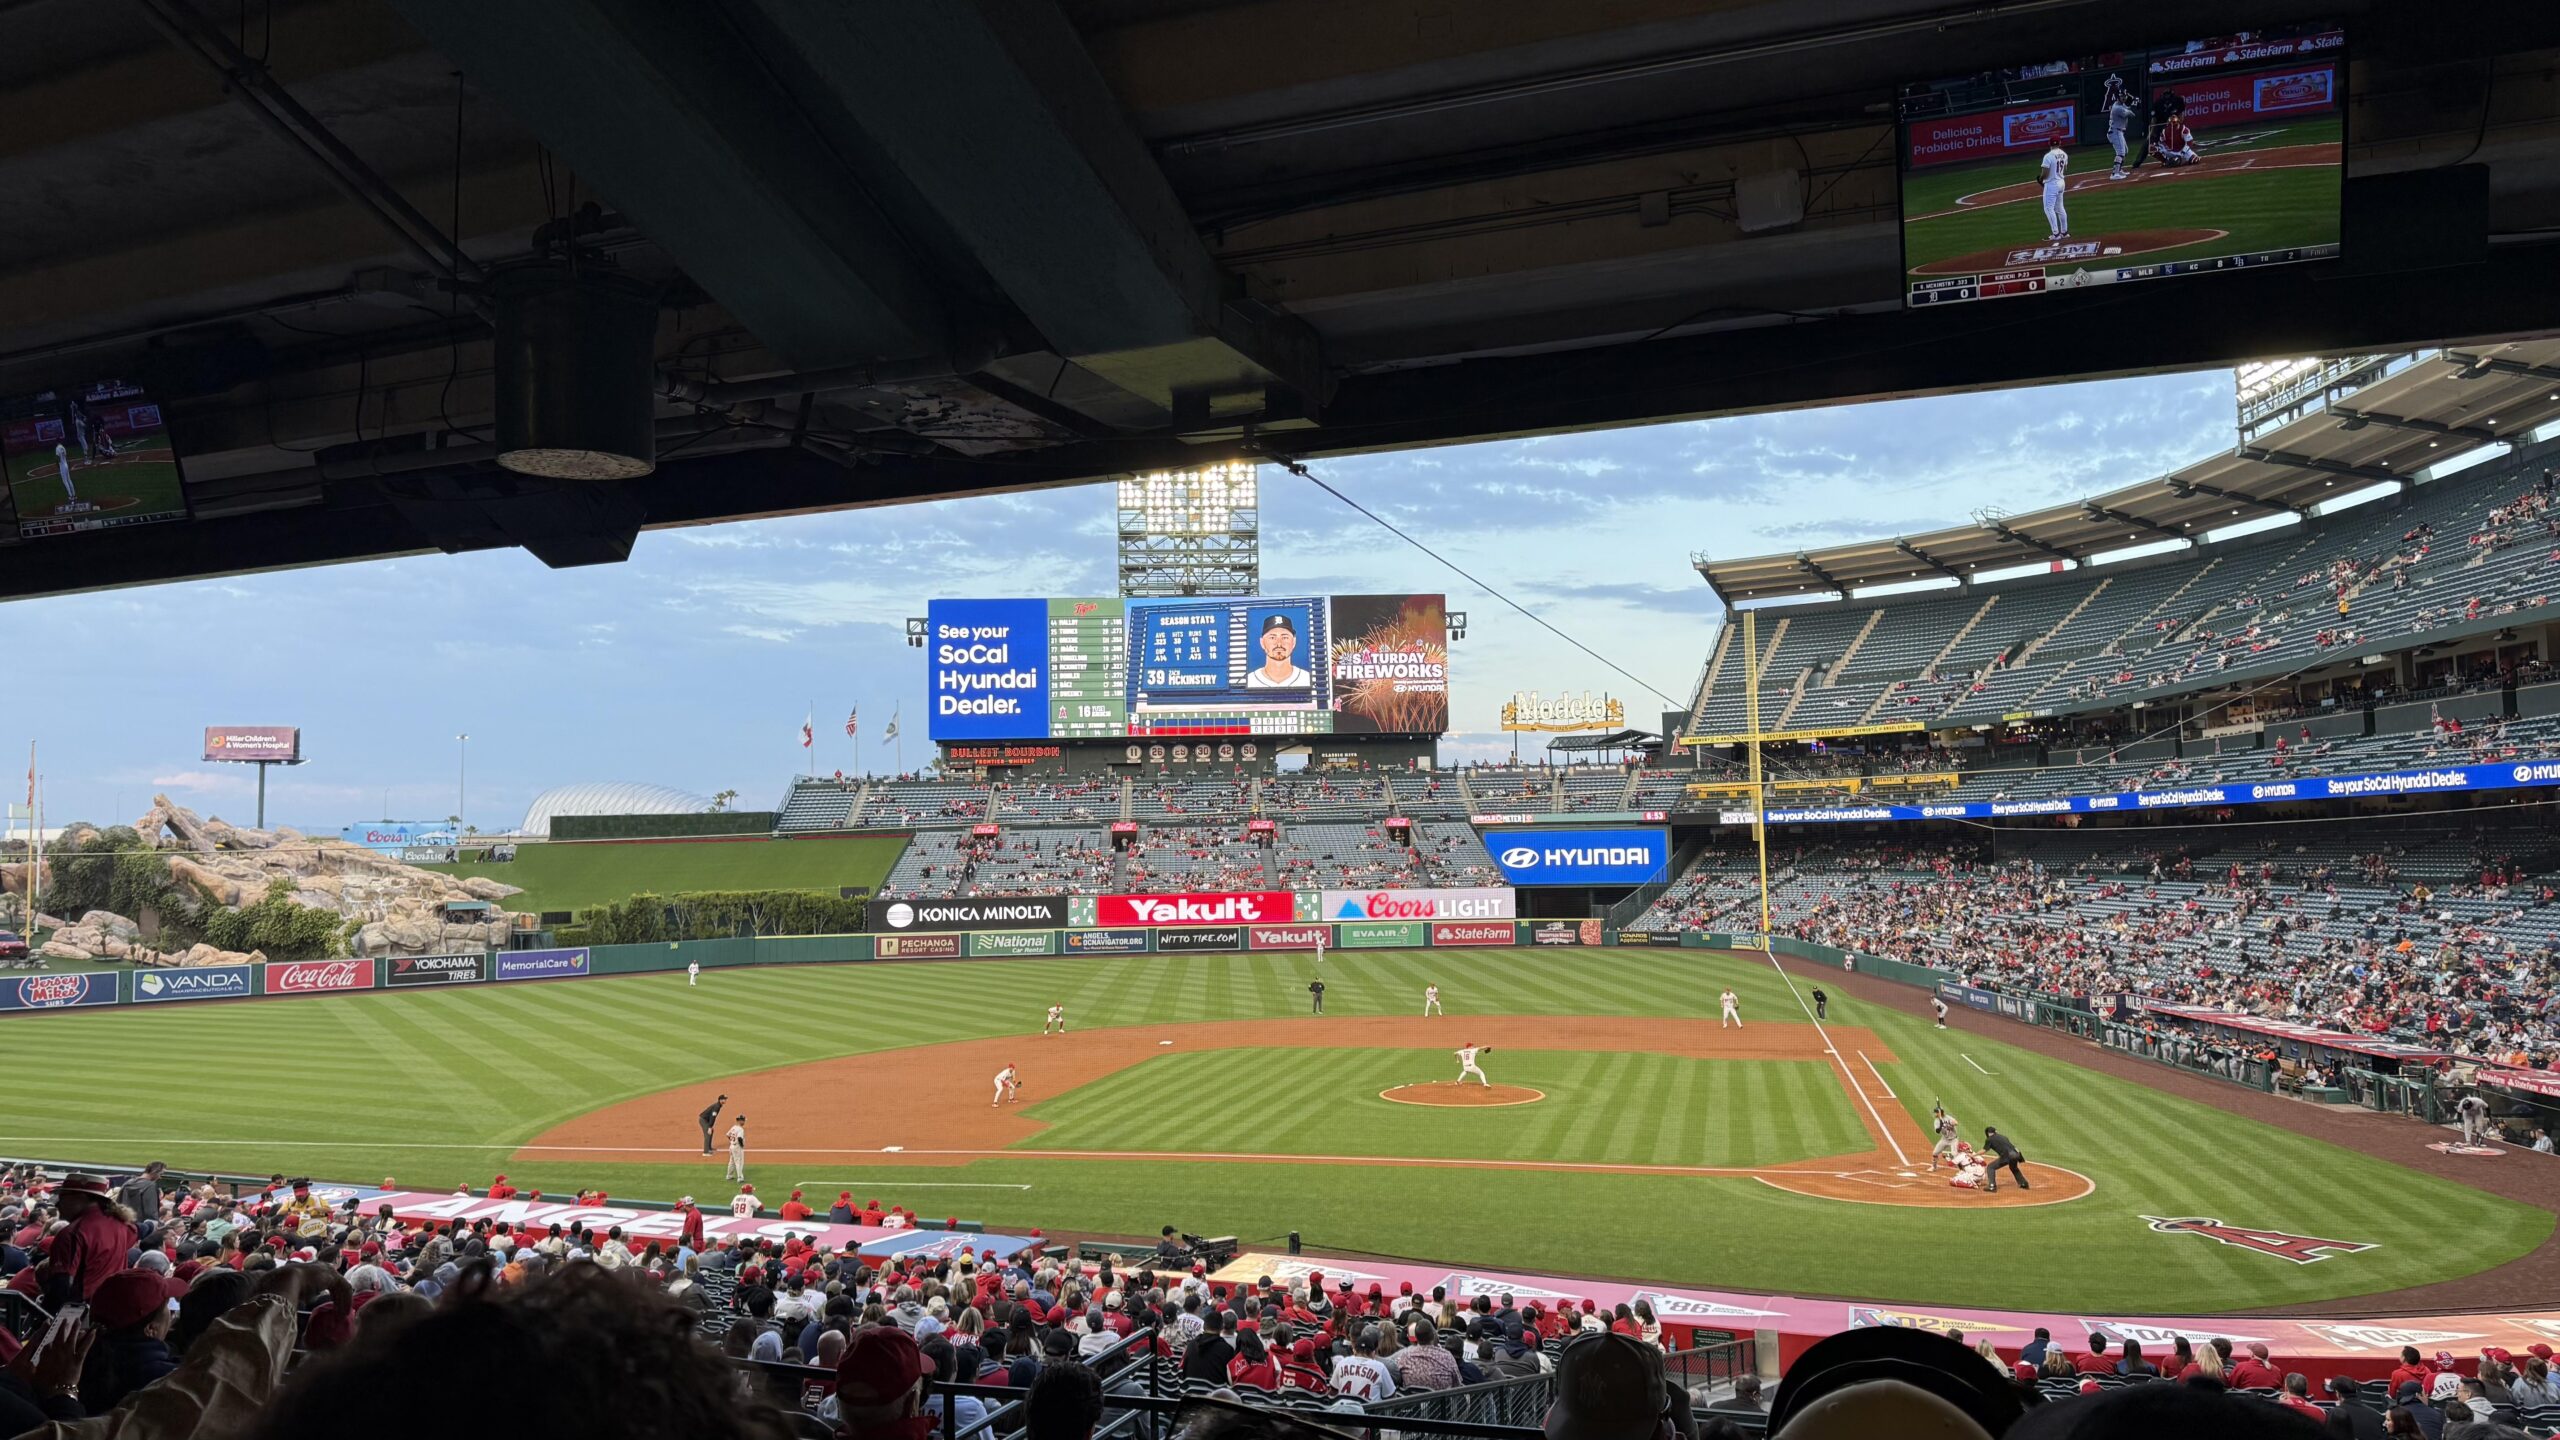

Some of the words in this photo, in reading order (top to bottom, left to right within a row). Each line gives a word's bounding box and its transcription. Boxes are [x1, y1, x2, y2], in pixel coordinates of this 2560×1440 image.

[2240, 44, 2293, 60] StateFarm
[2164, 55, 2216, 71] StateFarm
[2212, 100, 2252, 113] Drinks
[1933, 126, 1983, 140] Delicious
[1914, 140, 1963, 156] Probiotic
[1966, 136, 2002, 149] Drinks
[2190, 263, 2199, 271] KC
[2217, 259, 2223, 268] 8
[2138, 268, 2153, 277] MLB
[2029, 281, 2037, 291] 0
[1960, 289, 1969, 299] 0
[1160, 617, 1189, 626] SEASON
[1190, 615, 1216, 625] STATS
[938, 624, 969, 640] See
[972, 625, 1009, 641] your
[938, 643, 1008, 664] SoCal
[1352, 650, 1426, 665] SATURDAY
[1147, 670, 1165, 685] 39
[1336, 664, 1443, 680] FIREWORKS
[939, 668, 1037, 693] Hyundai
[1168, 675, 1217, 685] MCKINSTRY
[939, 694, 1021, 716] Dealer.
[1078, 705, 1091, 718] 16
[1516, 690, 1606, 720] Modelo
[950, 747, 999, 758] BULLEIT
[1004, 746, 1060, 757] BOURBON
[1130, 748, 1138, 756] 11
[1152, 747, 1162, 756] 26
[1198, 747, 1209, 755] 30
[1220, 746, 1232, 755] 42
[1244, 746, 1255, 754] 50
[2328, 779, 2344, 793] See
[2344, 781, 2363, 795] your
[2364, 776, 2391, 791] SoCal
[2391, 774, 2432, 791] Hyundai
[2432, 770, 2467, 786] Dealer.
[2264, 784, 2295, 796] HYUNDAI
[1768, 811, 1787, 822] See
[1787, 812, 1803, 823] your
[1804, 810, 1829, 821] SoCal
[1830, 808, 1863, 821] Hyundai
[1864, 807, 1892, 819] Dealer.
[1934, 806, 1966, 816] HYUNDAI
[1992, 804, 2005, 814] See
[367, 831, 401, 843] Coors
[1545, 848, 1650, 866] HYUNDAI
[1087, 898, 1094, 908] 2
[1311, 893, 1318, 904] 0
[1366, 892, 1436, 918] Coors
[1439, 898, 1503, 918] LIGHT
[919, 906, 980, 922] KONICA
[983, 905, 1051, 921] MINOLTA
[1128, 898, 1261, 921] Yakult
[1311, 911, 1318, 920] 0
[1087, 915, 1094, 925] 4
[993, 934, 1047, 949] National
[1161, 934, 1190, 944] NITTO
[1193, 932, 1237, 943] TIRE.COM
[1255, 929, 1323, 944] Yakult
[1455, 928, 1511, 941] StateFarm
[901, 939, 954, 948] PECHANGA
[1083, 937, 1144, 947] OCNAVIGATOR.ORG
[414, 957, 477, 971] YOKOHAMA
[501, 958, 568, 971] MemorialCare
[166, 974, 244, 989] VANDA
[280, 962, 358, 989] Coca-Cola
[448, 970, 476, 980] TIRES
[29, 976, 79, 990] Jersey
[30, 987, 79, 1002] Mike's
[45, 999, 64, 1007] SUBS
[2125, 995, 2141, 1009] MLB
[2514, 1079, 2539, 1092] StateFarm
[394, 1196, 832, 1246] ANGELS
[1472, 1281, 1514, 1295] '82
[1666, 1300, 1712, 1314] '86
[2350, 1329, 2417, 1343] '05
[1340, 1365, 1379, 1384] JACKSON
